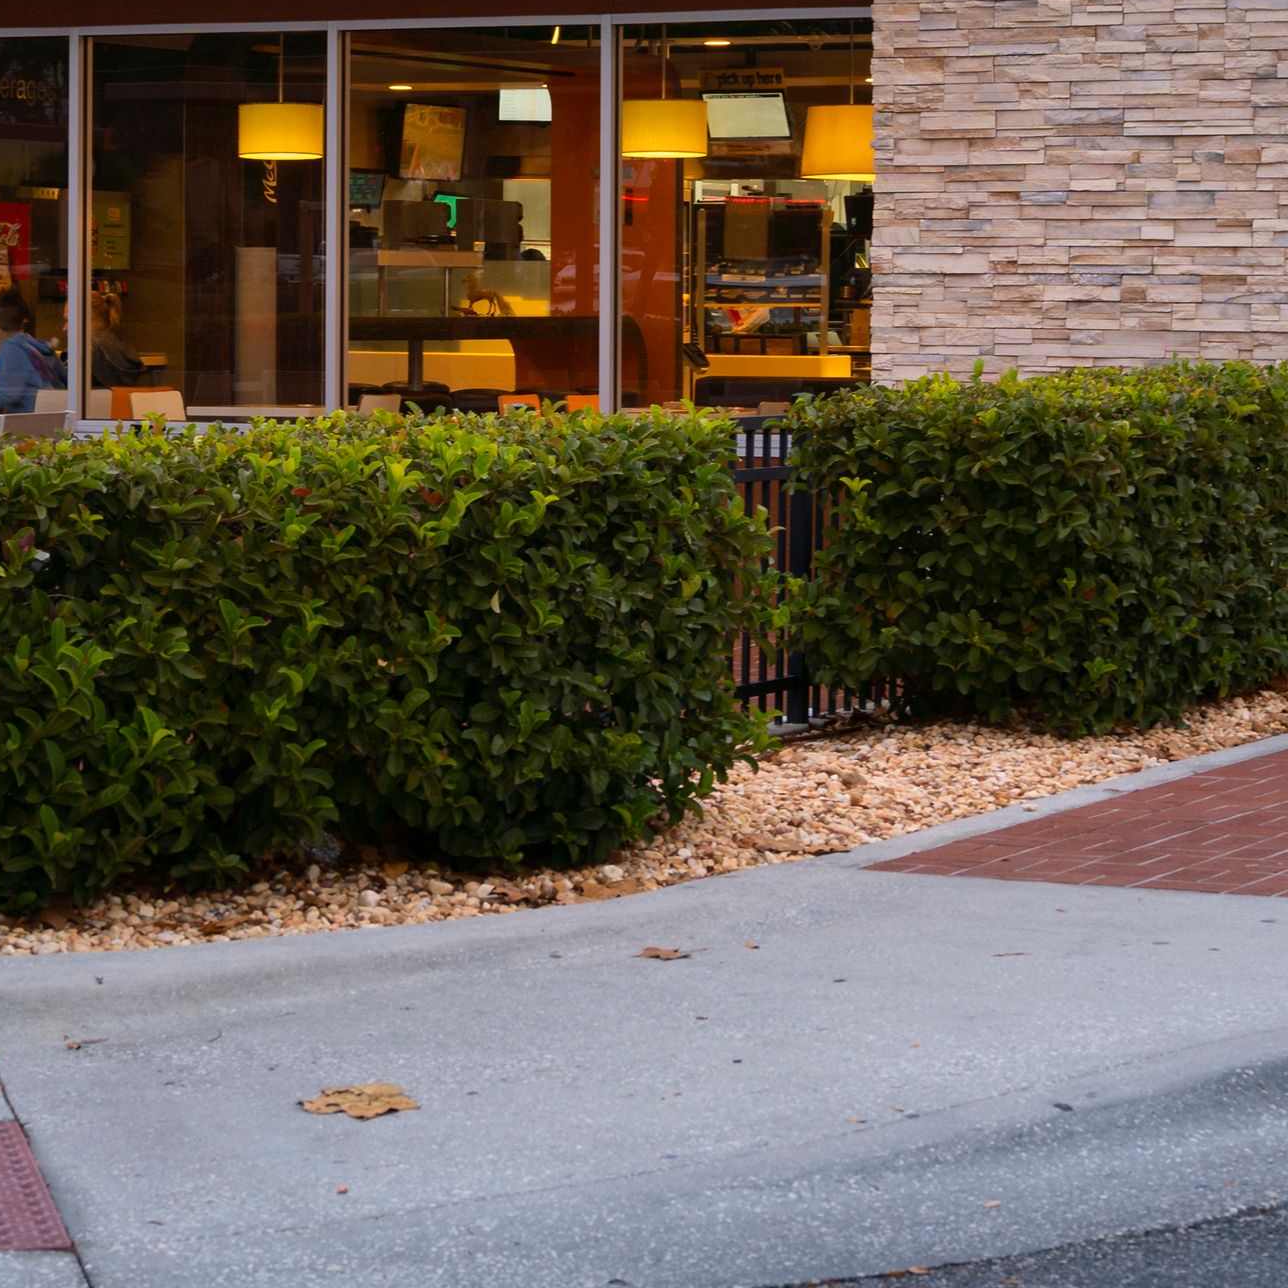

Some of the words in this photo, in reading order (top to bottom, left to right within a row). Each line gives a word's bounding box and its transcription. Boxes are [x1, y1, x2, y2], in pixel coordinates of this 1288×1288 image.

[716, 72, 741, 87] pick
[742, 75, 755, 87] up
[756, 72, 782, 84] here
